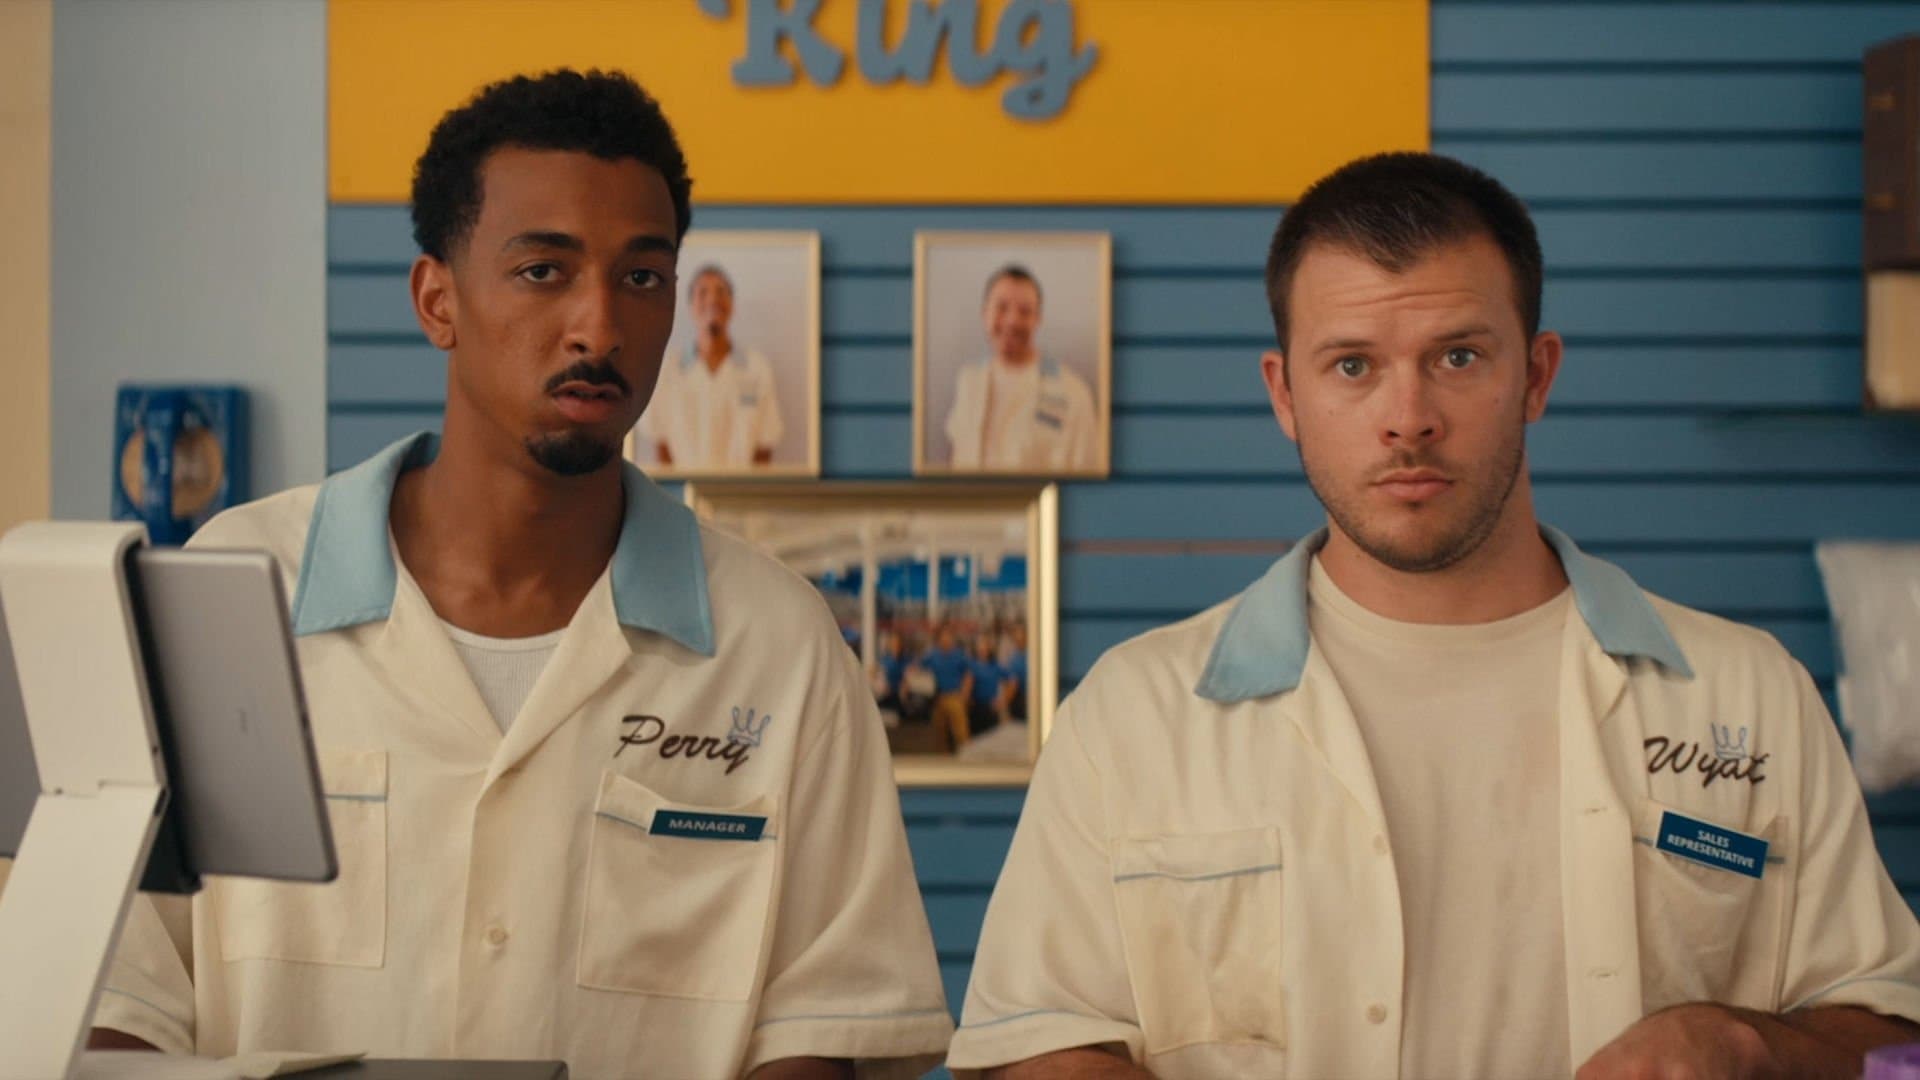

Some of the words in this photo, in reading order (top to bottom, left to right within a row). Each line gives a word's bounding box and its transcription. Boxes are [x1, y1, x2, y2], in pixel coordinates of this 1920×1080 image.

[699, 0, 1099, 121] King
[613, 714, 749, 775] Perry
[668, 818, 747, 833] MANAGER
[1697, 829, 1730, 848] SALES
[1666, 833, 1755, 868] REPRESENTATIVE
